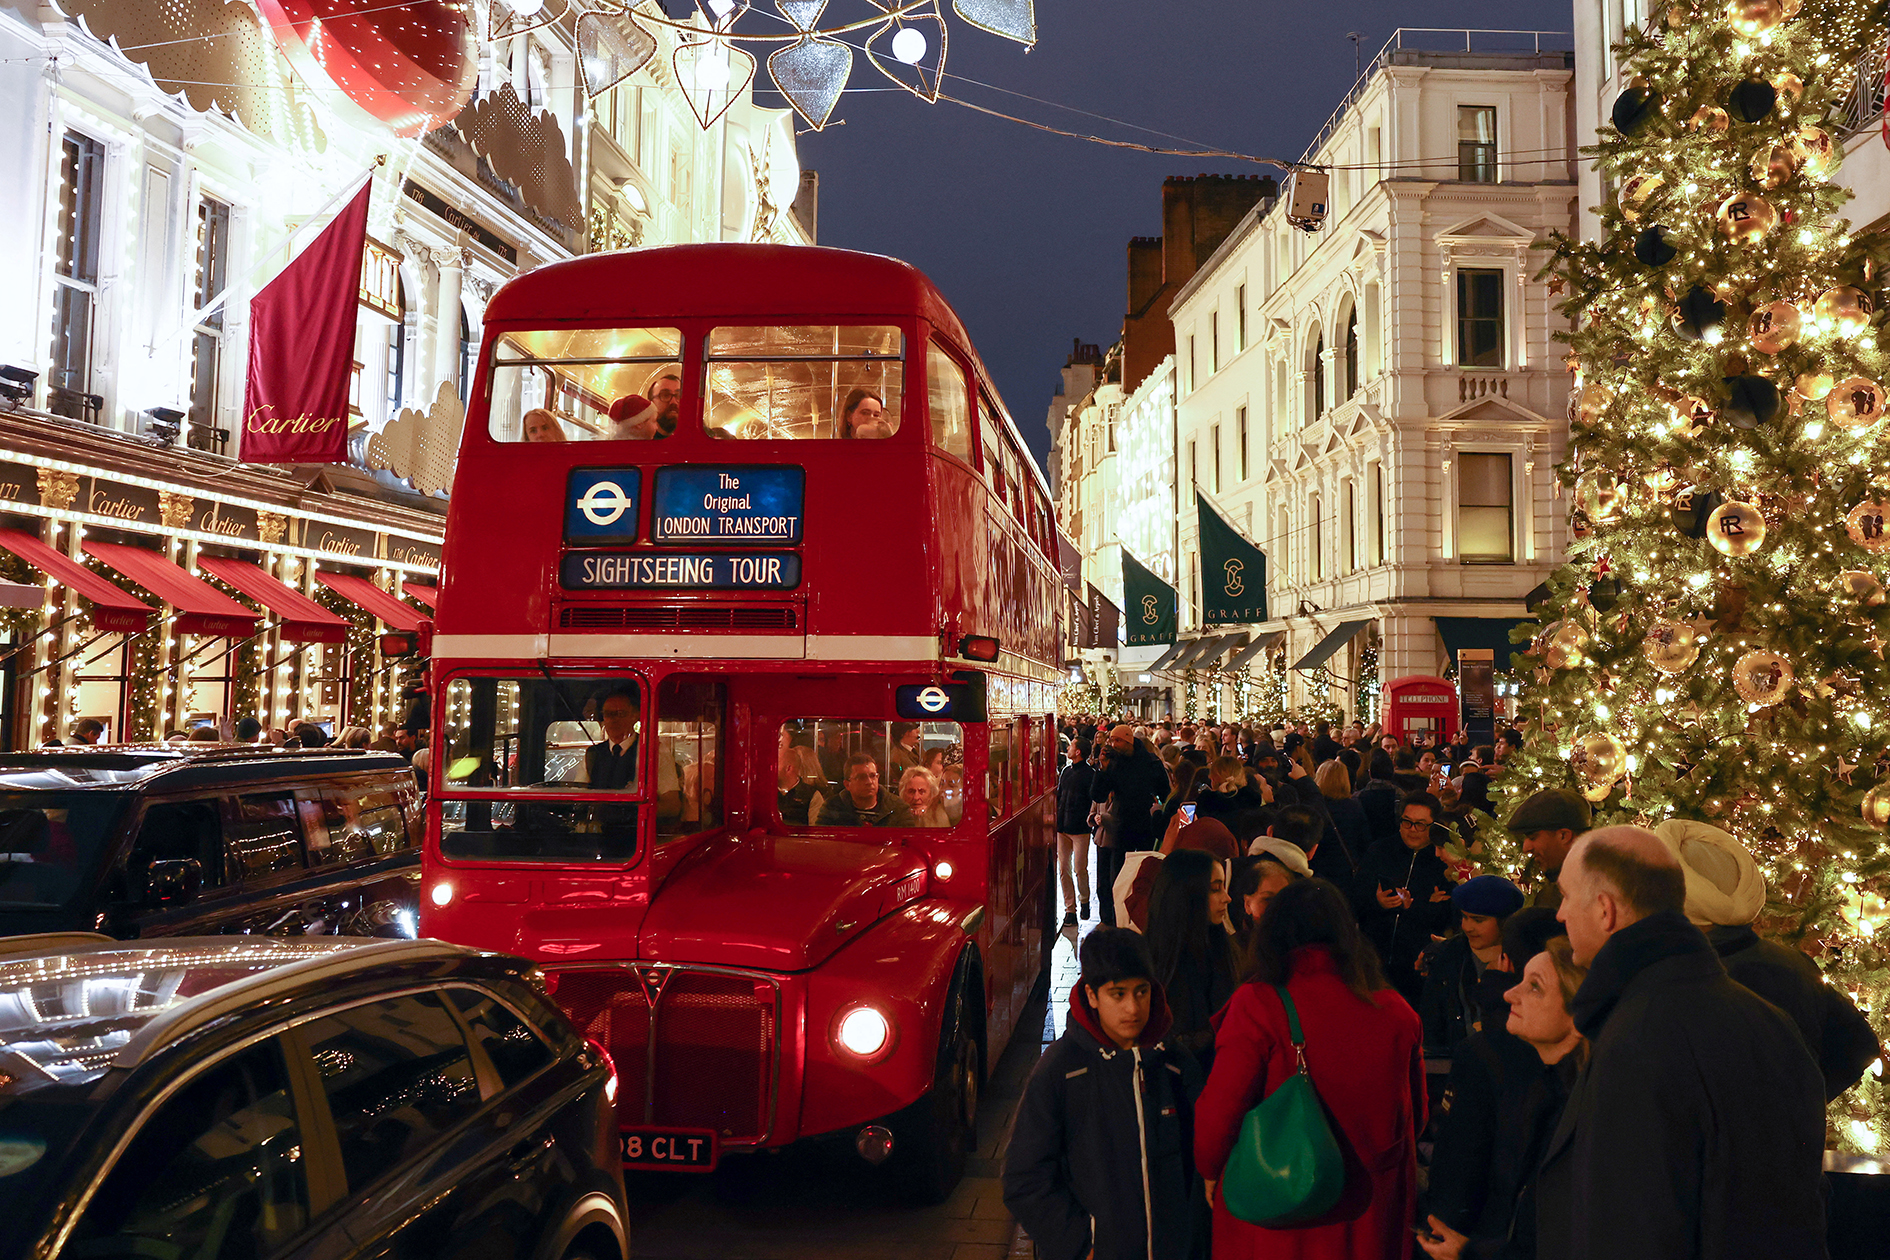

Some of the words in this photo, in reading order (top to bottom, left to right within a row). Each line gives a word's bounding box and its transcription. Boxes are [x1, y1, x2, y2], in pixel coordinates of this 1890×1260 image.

[444, 205, 472, 233] Cartier
[247, 404, 341, 434] Cartier
[718, 473, 740, 490] The
[90, 490, 145, 520] Cartier
[703, 493, 752, 514] Original
[200, 511, 246, 536] Cartier
[656, 517, 710, 539] LONDON
[718, 516, 798, 538] TRANSPORT
[1719, 515, 1745, 536] RL
[319, 531, 361, 557] Cartier
[405, 546, 439, 568] Cartier
[582, 558, 714, 584] SIGHTSEEING
[729, 558, 782, 584] TOUR
[104, 611, 136, 626] Cartier
[1207, 607, 1262, 620] GRAFF
[203, 618, 230, 631] Cartier
[302, 626, 324, 638] Cartier
[1130, 632, 1173, 642] GRAFF
[1400, 695, 1448, 703] TELEPHONE
[896, 883, 907, 902] RM
[619, 1135, 643, 1158] 8
[651, 1136, 703, 1161] CLT
